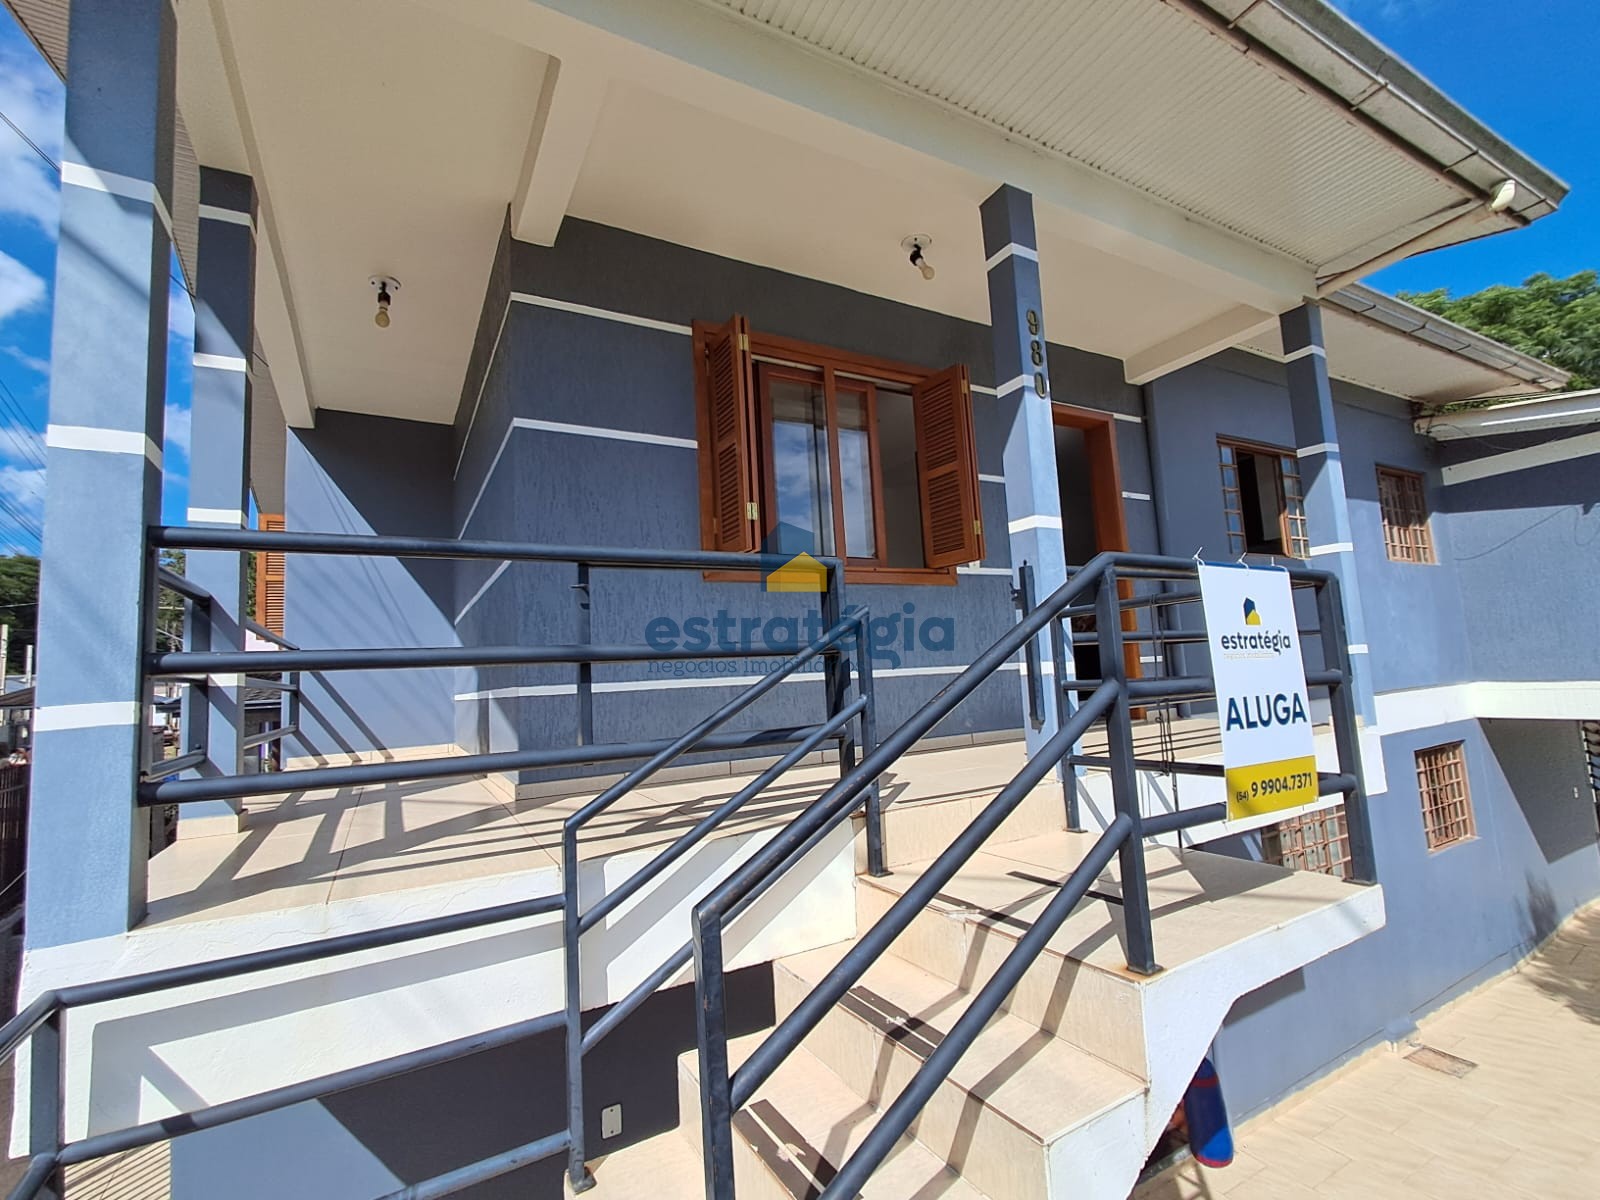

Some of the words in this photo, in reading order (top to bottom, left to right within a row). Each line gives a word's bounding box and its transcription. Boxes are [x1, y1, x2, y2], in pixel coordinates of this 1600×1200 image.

[1026, 308, 1047, 400] 980
[1221, 630, 1291, 655] estratégia
[1226, 692, 1307, 731] ALUGA
[1236, 791, 1249, 803] (54)
[1251, 782, 1258, 798] 9
[1261, 772, 1312, 795] 9904.7371
